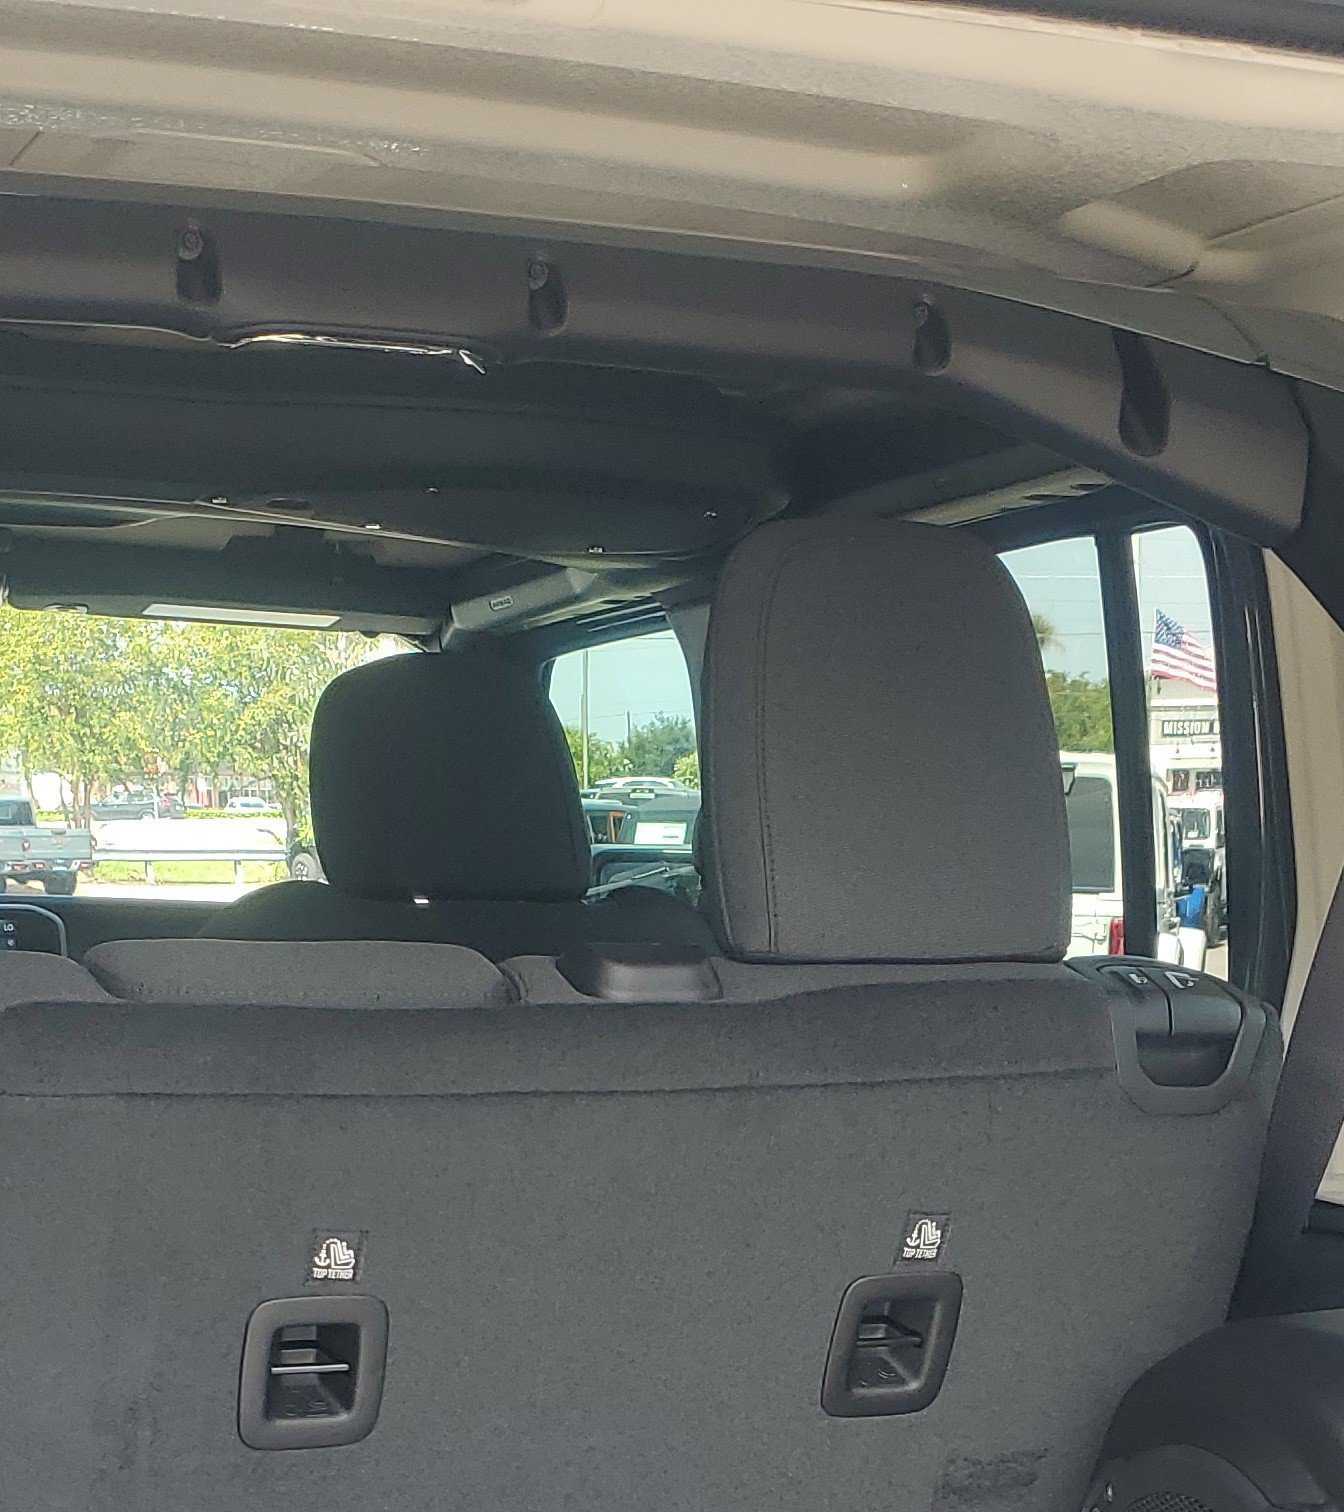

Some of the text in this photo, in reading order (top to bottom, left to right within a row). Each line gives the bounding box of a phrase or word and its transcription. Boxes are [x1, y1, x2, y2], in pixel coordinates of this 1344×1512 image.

[1163, 720, 1210, 735] MISSION
[902, 1247, 916, 1258] TOP
[312, 1268, 354, 1280] TOP TETHER
